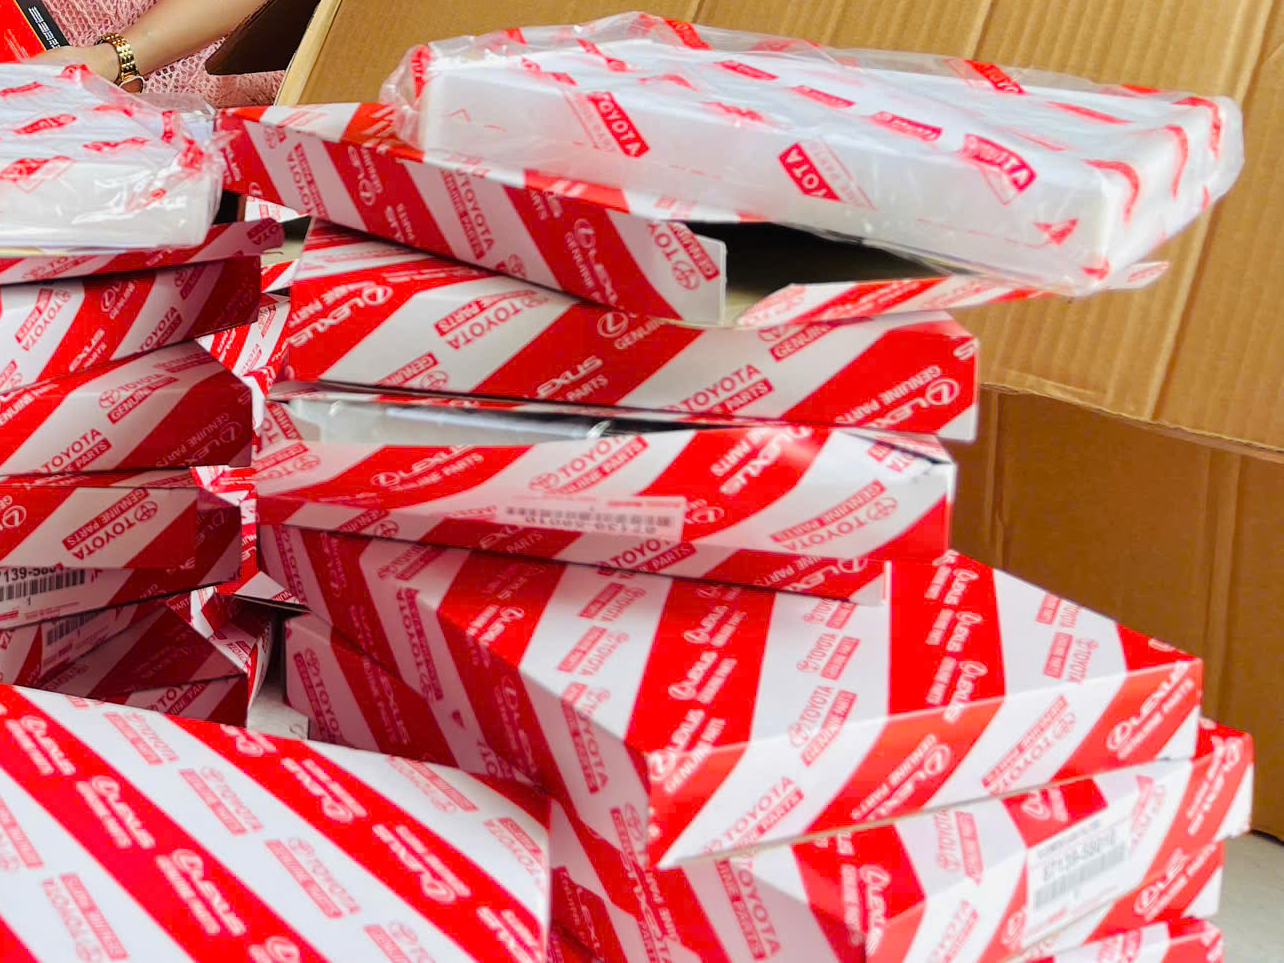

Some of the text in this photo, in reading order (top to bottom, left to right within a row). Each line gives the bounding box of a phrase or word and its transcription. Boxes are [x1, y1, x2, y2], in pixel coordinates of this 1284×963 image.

[23, 296, 64, 352] TOYOTA
[445, 299, 522, 350] TOYOTA
[679, 363, 761, 414] TOYOTA
[40, 428, 103, 474] TOYOTA
[72, 507, 142, 561] TOYOTA
[779, 509, 870, 551] TOYOTA
[723, 776, 795, 840] TOYOTA
